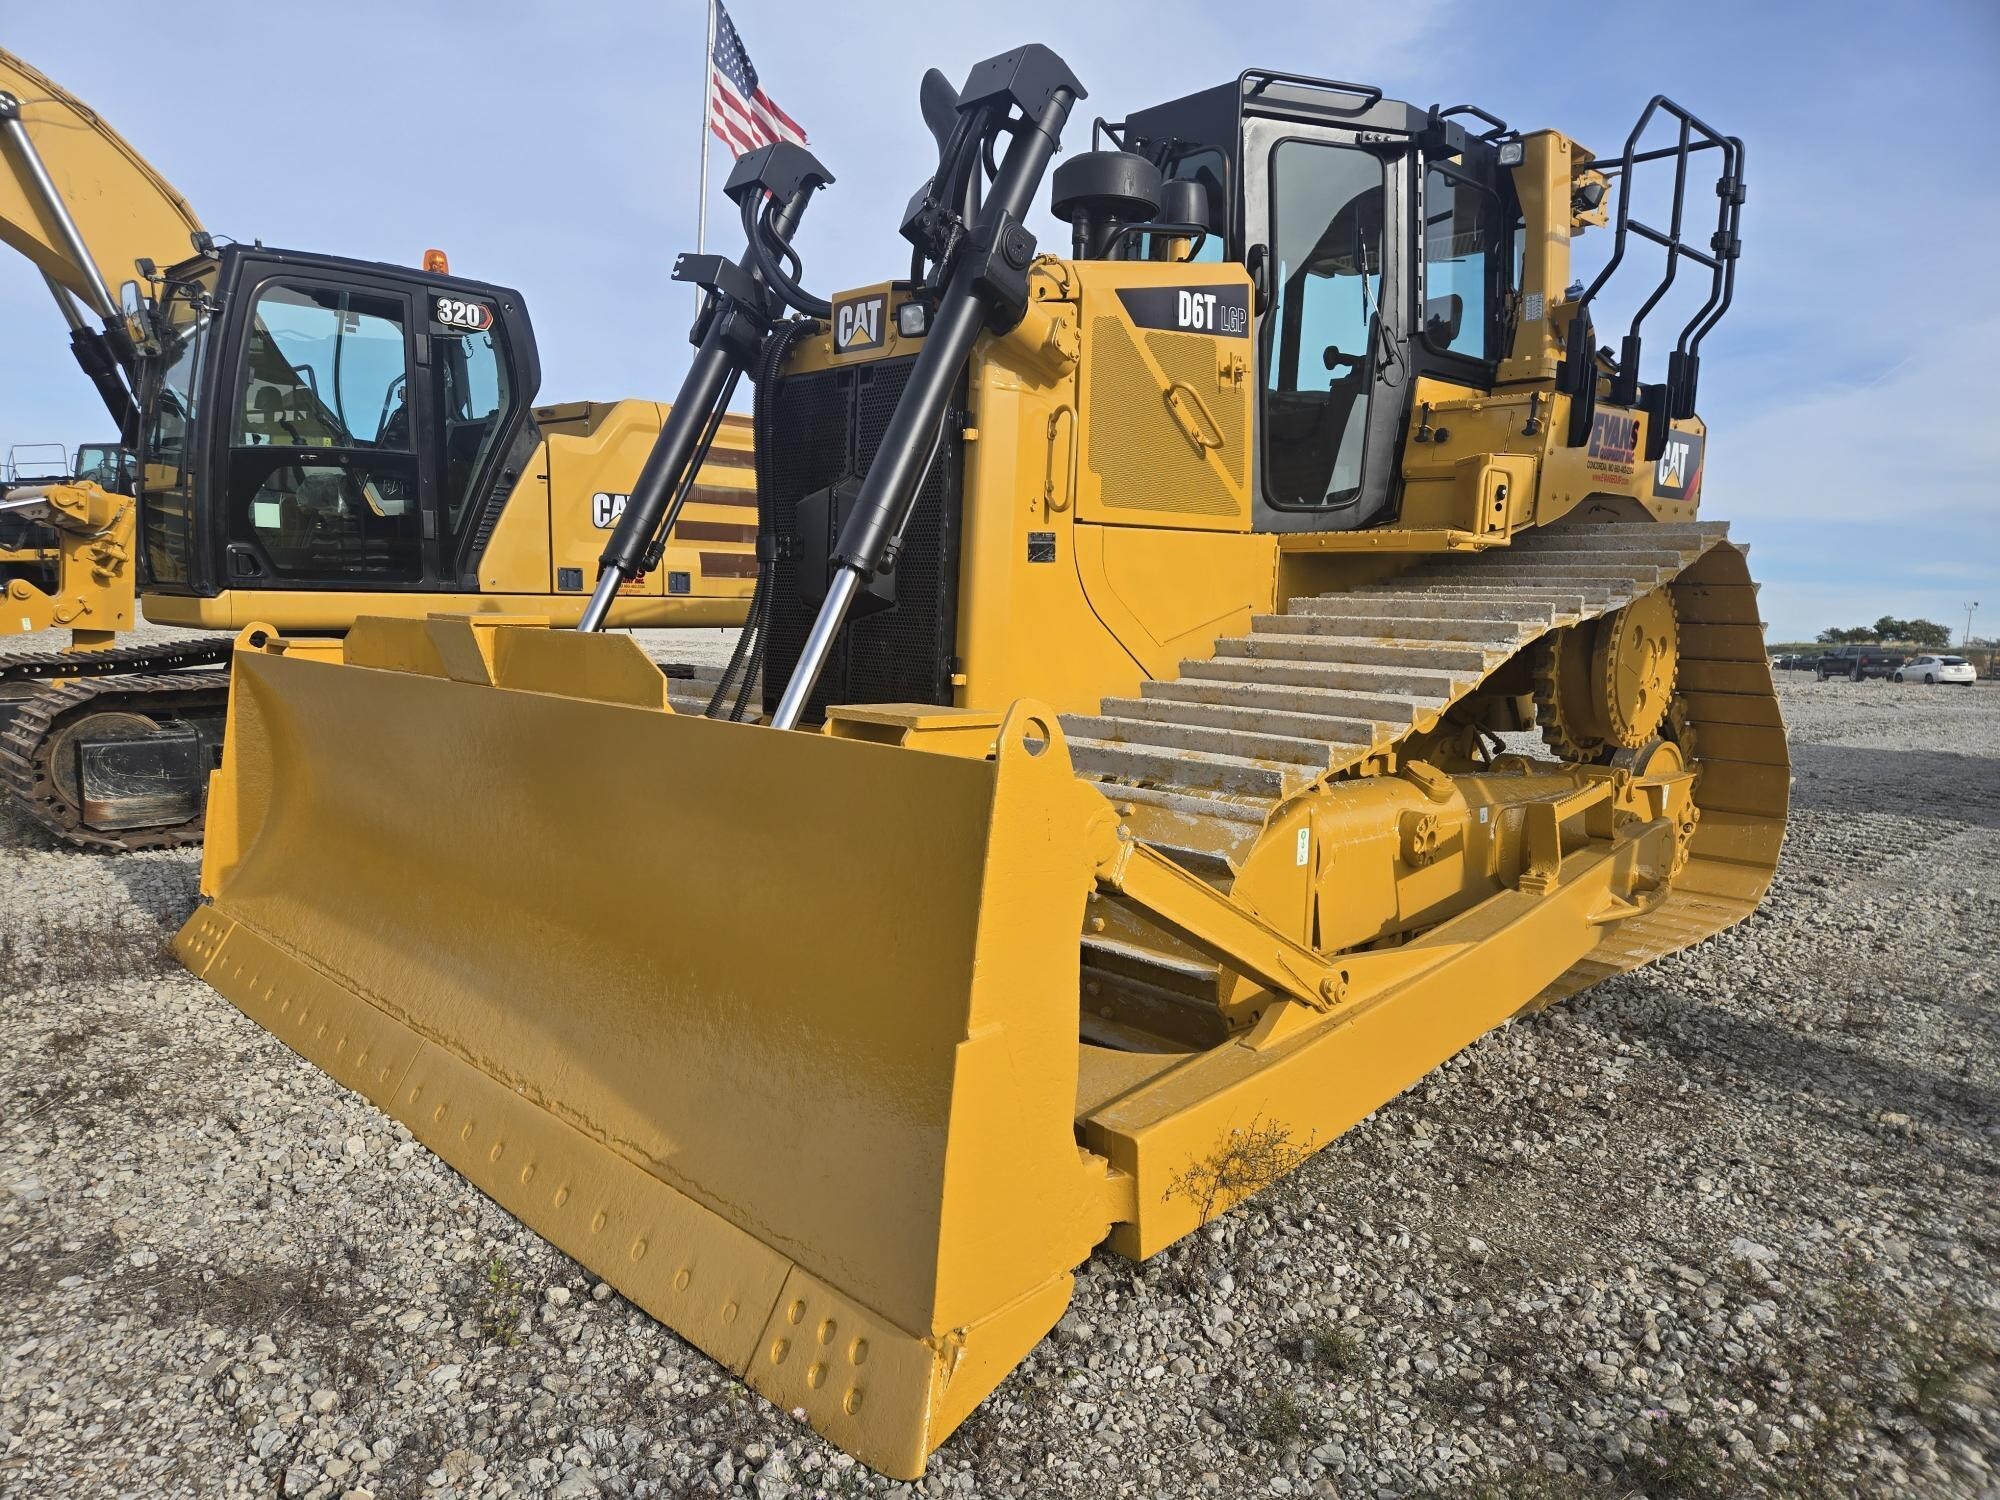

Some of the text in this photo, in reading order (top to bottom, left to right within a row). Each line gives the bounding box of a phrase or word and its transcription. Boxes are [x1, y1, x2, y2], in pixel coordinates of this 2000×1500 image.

[439, 298, 480, 327] 320
[838, 299, 882, 347] CAT
[1178, 290, 1247, 332] D6T LGP
[1588, 412, 1640, 458] EVANS
[1658, 440, 1689, 489] CAT
[593, 493, 630, 528] CA
